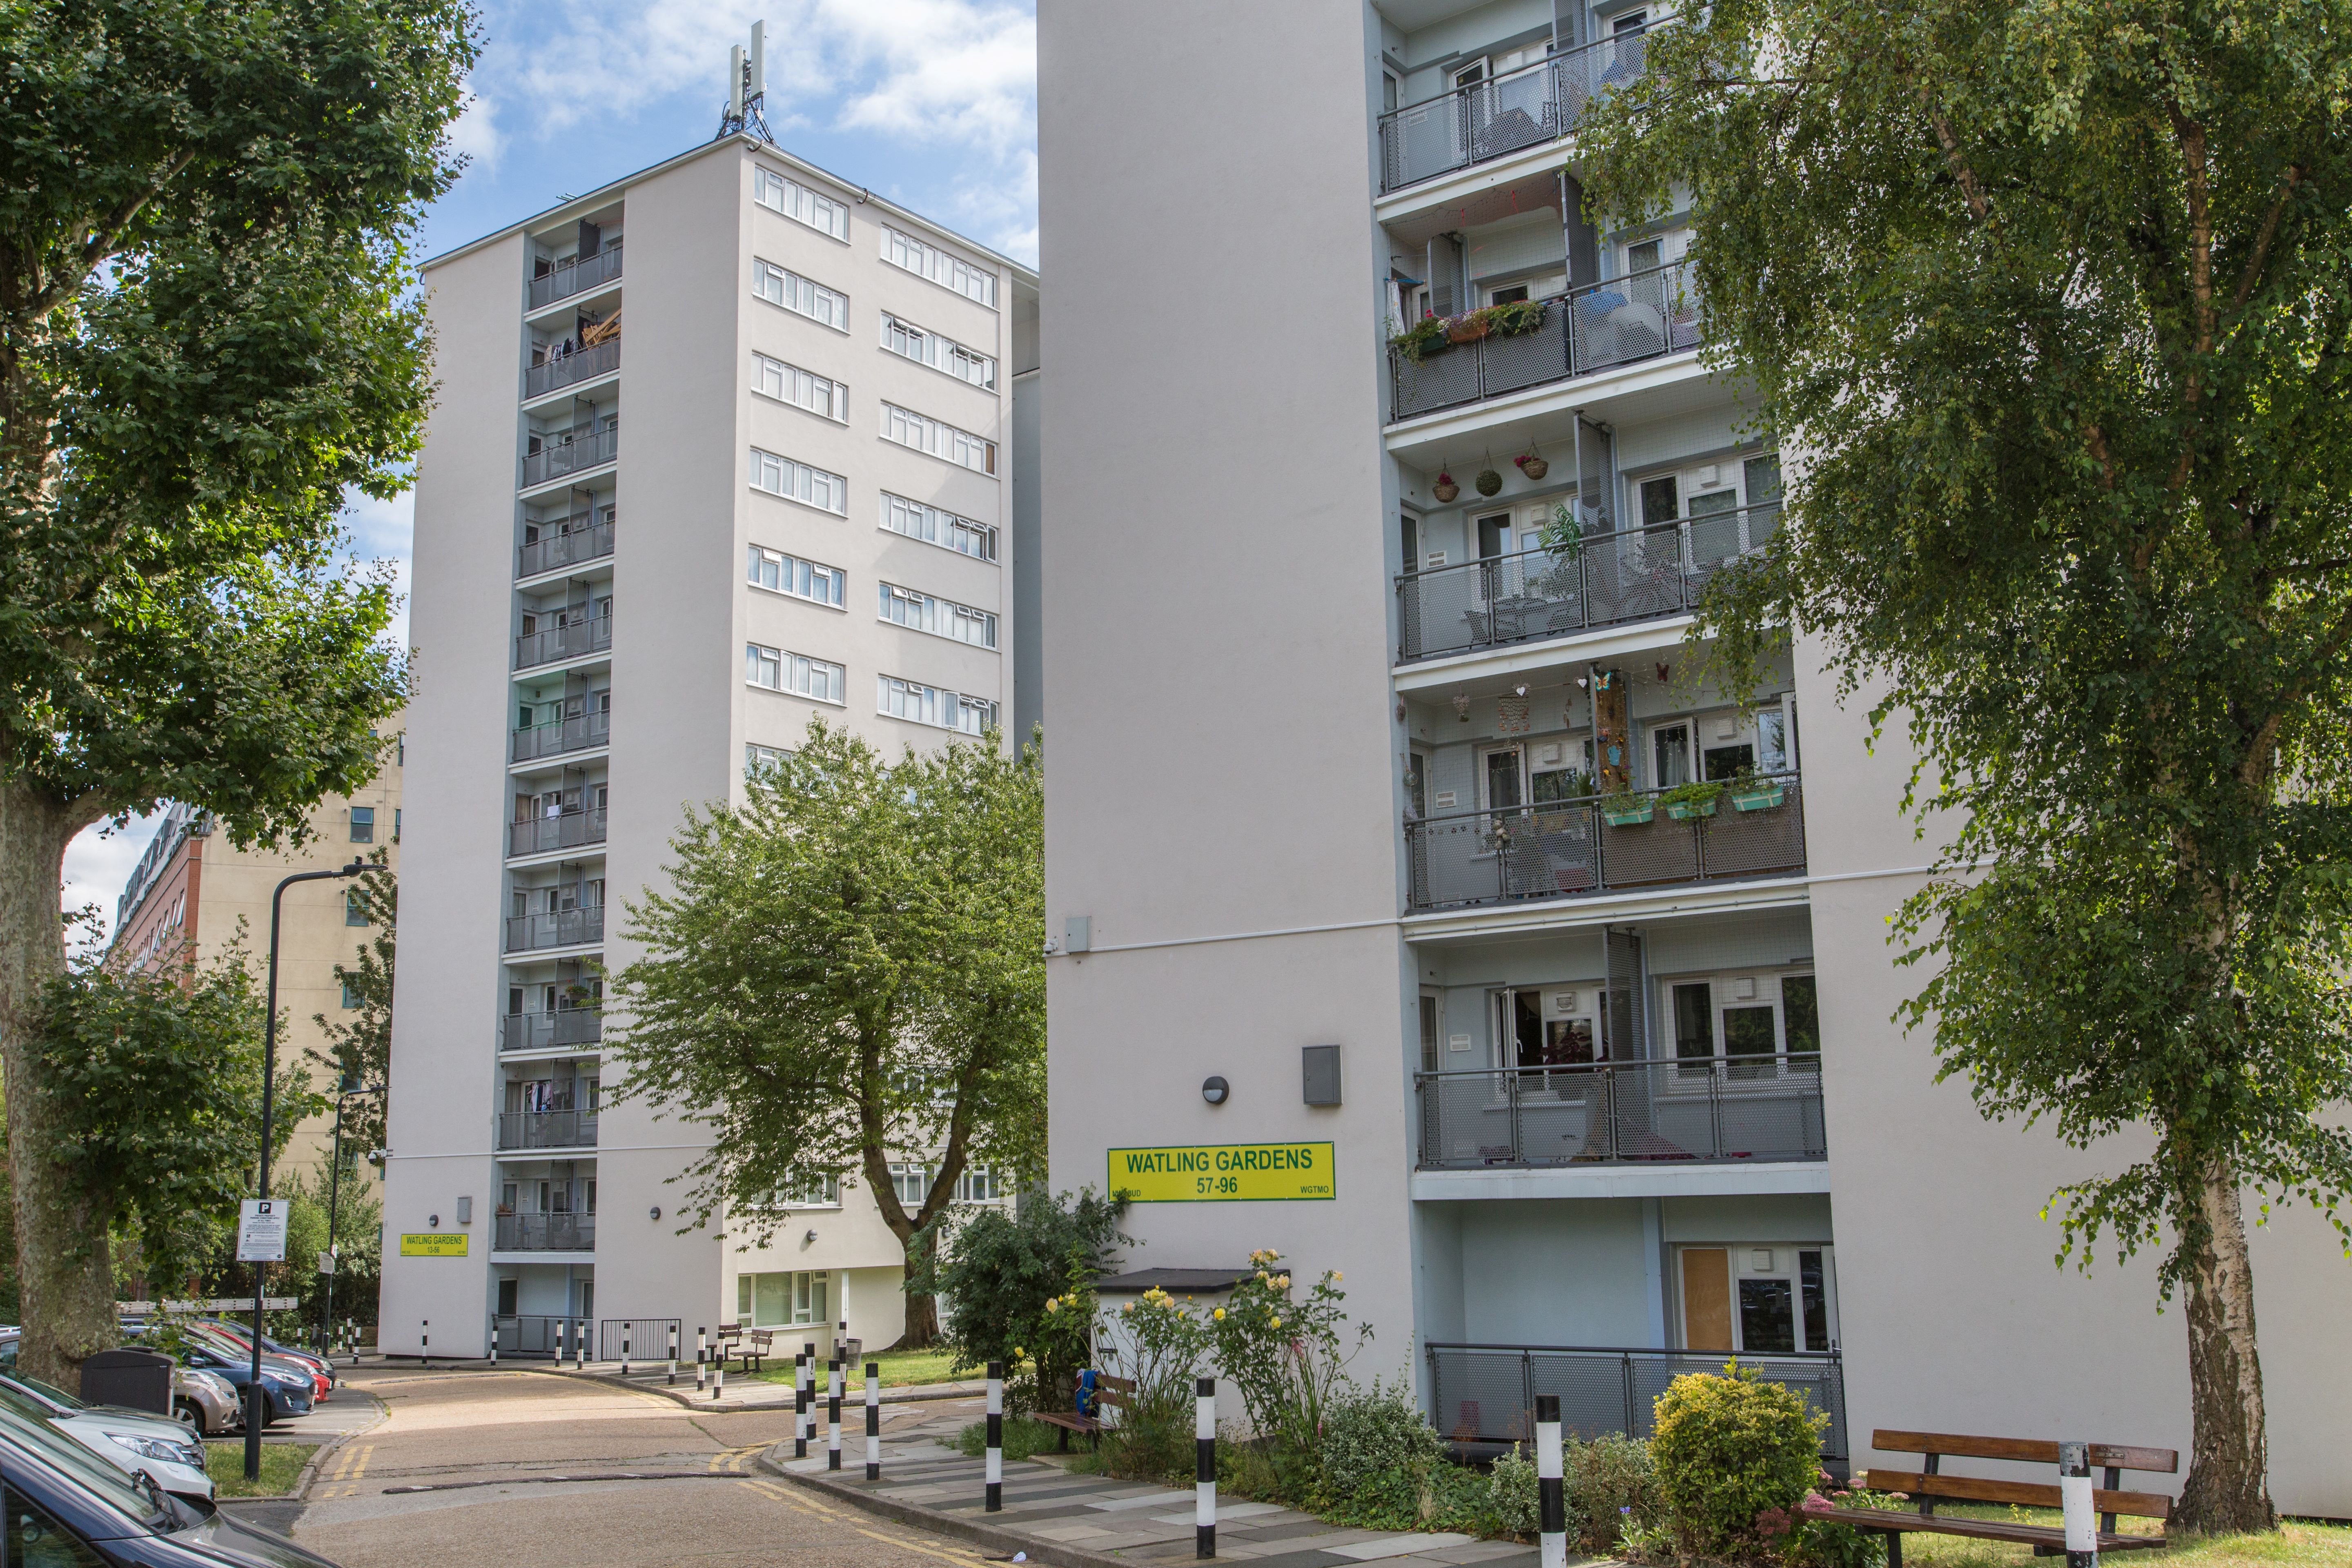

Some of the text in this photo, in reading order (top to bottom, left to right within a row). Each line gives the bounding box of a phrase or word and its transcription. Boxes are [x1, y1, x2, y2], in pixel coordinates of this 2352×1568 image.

[1127, 1149, 1313, 1173] WATLING GARDENS
[1197, 1176, 1238, 1194] 57-96
[1300, 1185, 1329, 1194] WGTMO
[261, 1204, 270, 1212] P
